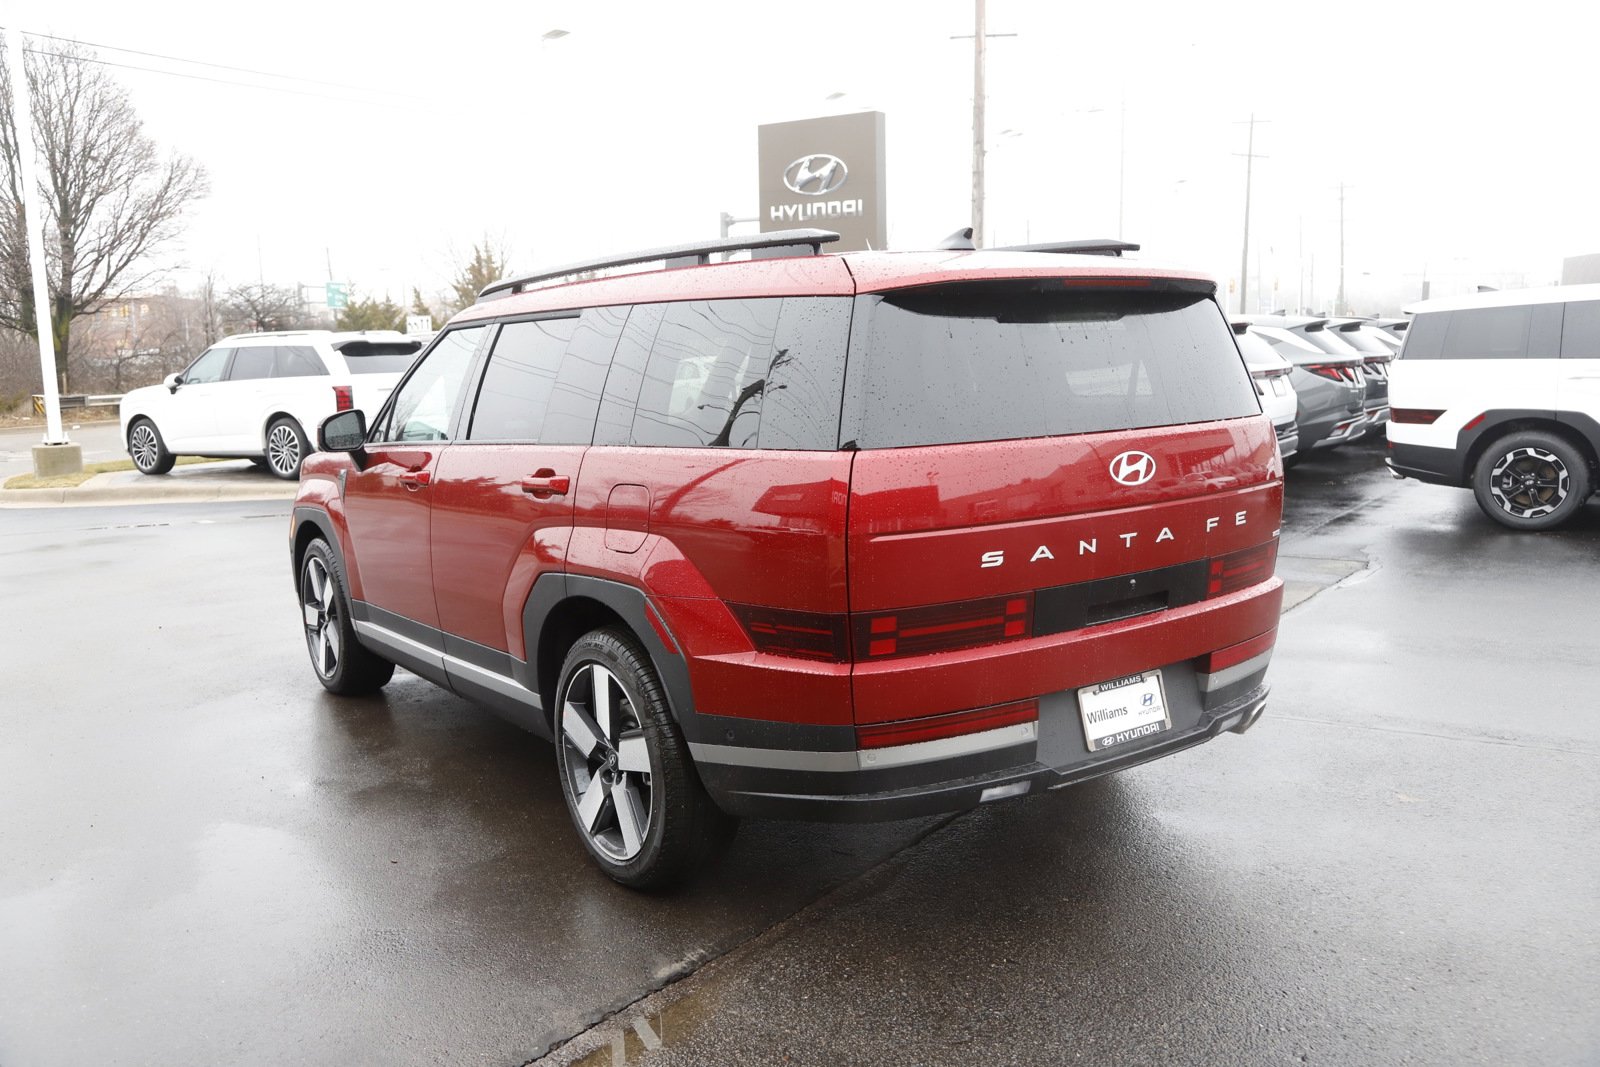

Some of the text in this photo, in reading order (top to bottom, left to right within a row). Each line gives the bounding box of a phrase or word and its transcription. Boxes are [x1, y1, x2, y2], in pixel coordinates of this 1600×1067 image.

[770, 199, 863, 221] HYUNDAI
[981, 511, 1247, 568] SANTA FE
[1100, 676, 1141, 691] WILLIAMS
[1087, 706, 1128, 724] Williams
[1138, 706, 1161, 716] HYUNDA
[1116, 723, 1159, 742] HYUNDAI
